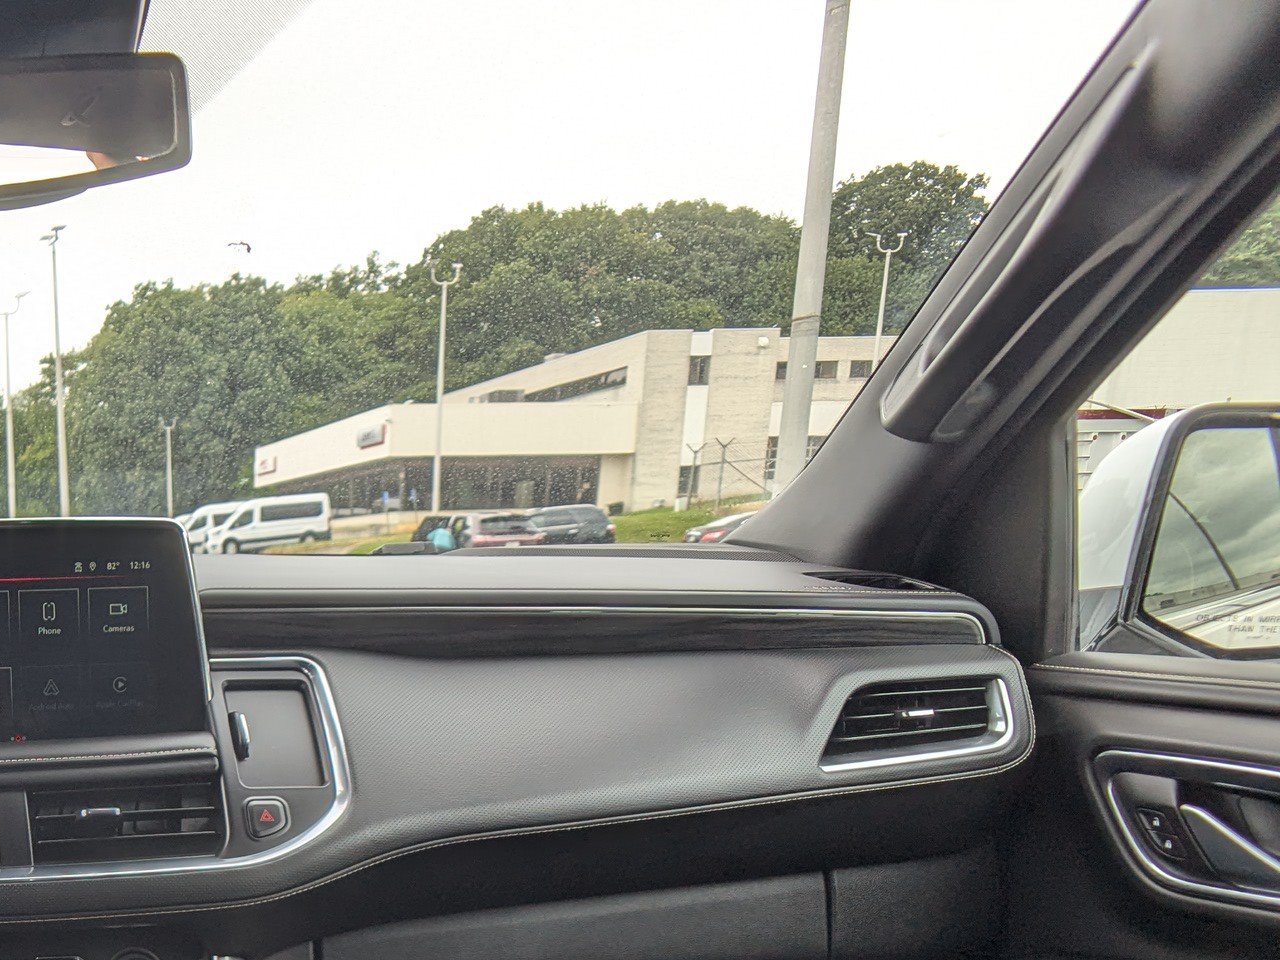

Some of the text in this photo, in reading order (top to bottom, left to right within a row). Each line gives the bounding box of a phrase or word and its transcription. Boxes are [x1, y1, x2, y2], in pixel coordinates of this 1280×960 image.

[130, 561, 151, 570] 12:16
[37, 626, 62, 635] Phone
[102, 625, 135, 633] Cameras
